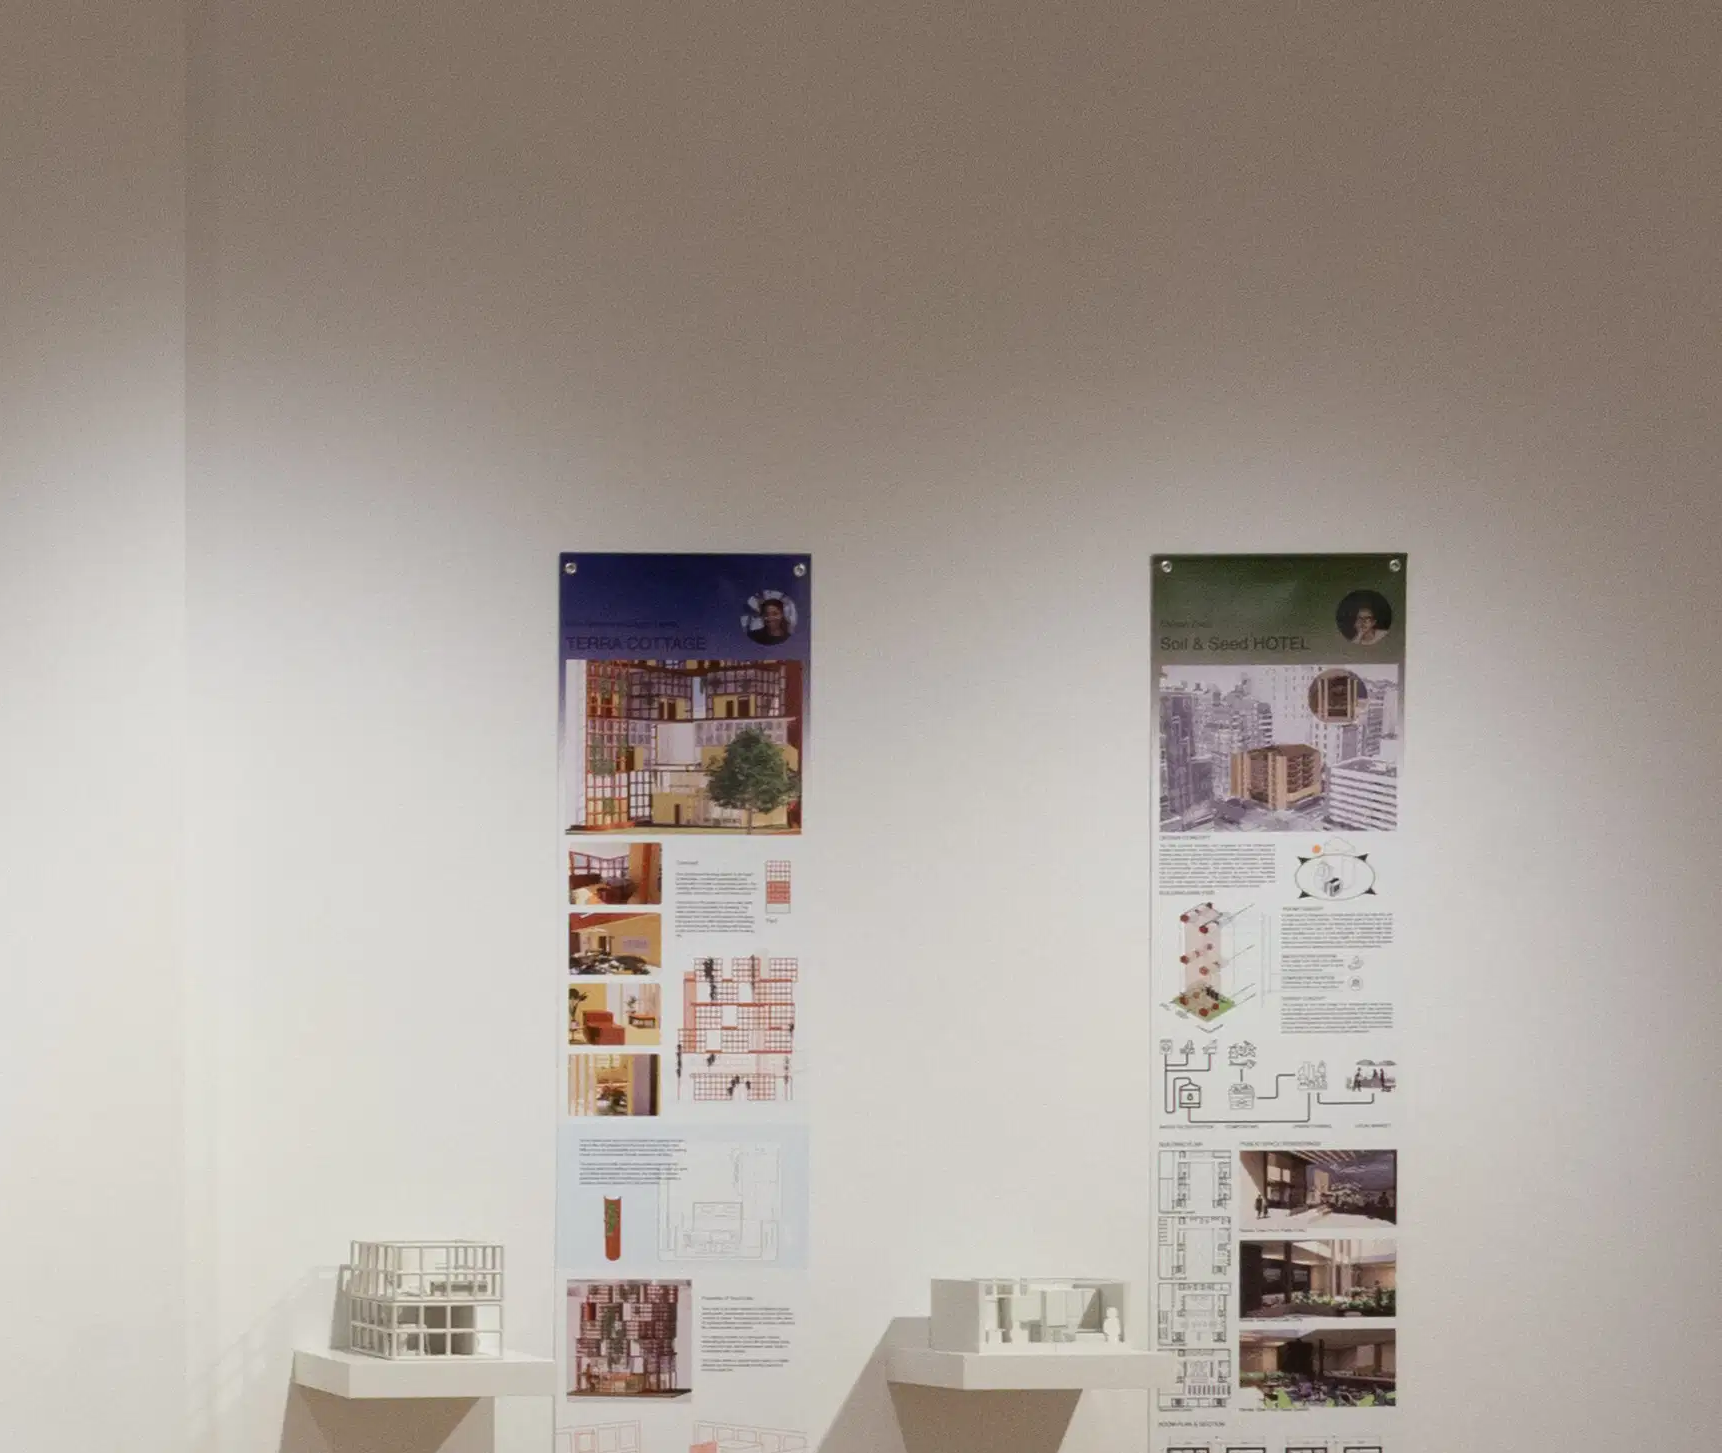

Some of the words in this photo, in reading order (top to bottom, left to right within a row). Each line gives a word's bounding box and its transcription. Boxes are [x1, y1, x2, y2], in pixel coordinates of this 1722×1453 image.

[566, 636, 623, 651] TERRA
[626, 636, 708, 651] COTTAGE
[1160, 636, 1188, 651] Soil
[1193, 636, 1203, 650] &
[1208, 636, 1248, 651] Seed
[1253, 636, 1310, 651] HOTEL
